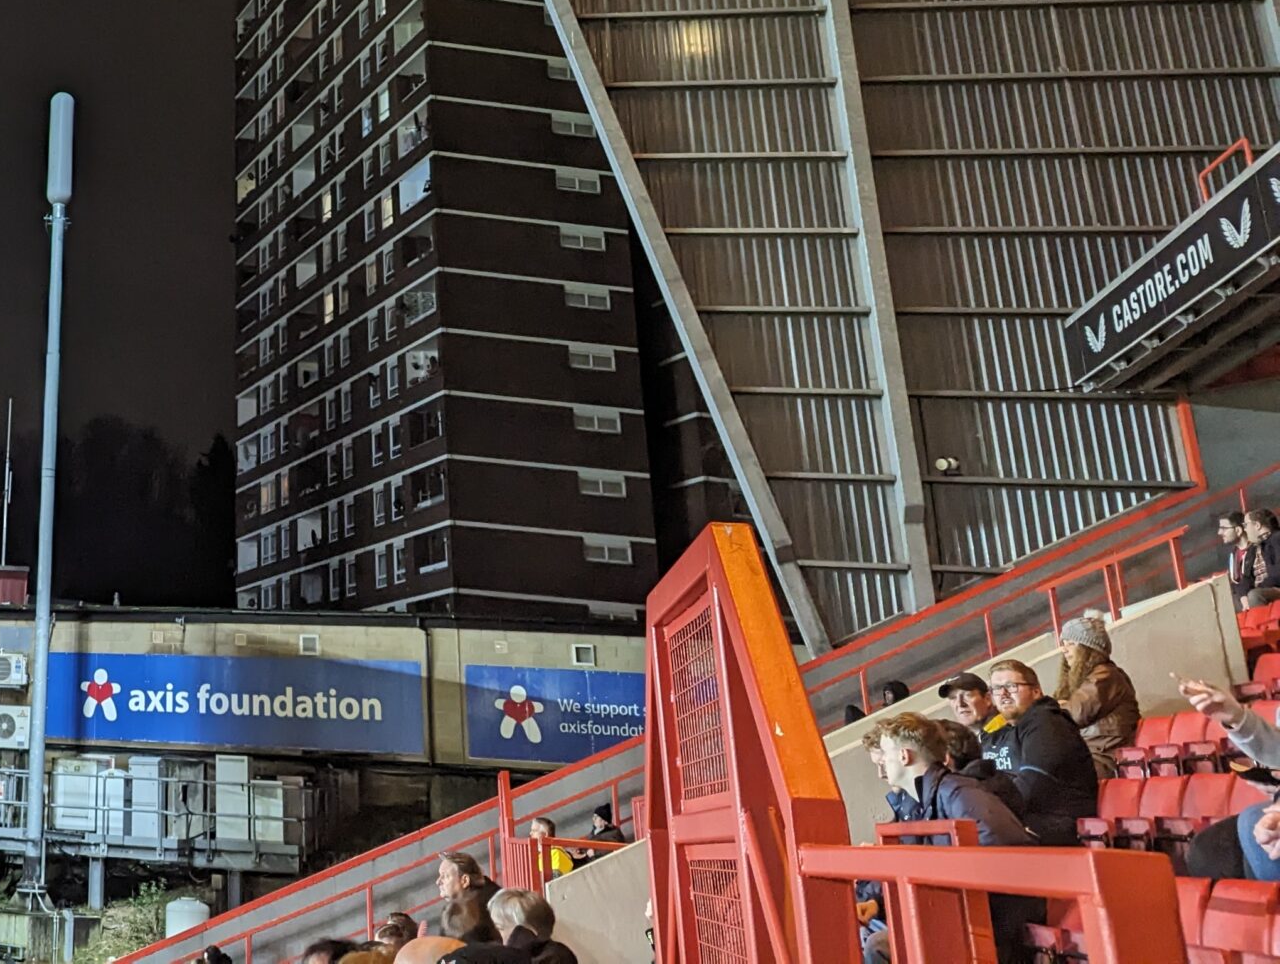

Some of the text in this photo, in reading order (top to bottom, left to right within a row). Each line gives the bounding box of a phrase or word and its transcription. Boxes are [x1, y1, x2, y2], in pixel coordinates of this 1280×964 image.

[1112, 233, 1214, 333] CASTORE.COM
[128, 683, 382, 721] axis foundation
[558, 698, 581, 712] We
[584, 703, 640, 718] support
[560, 720, 645, 737] axisfoundat
